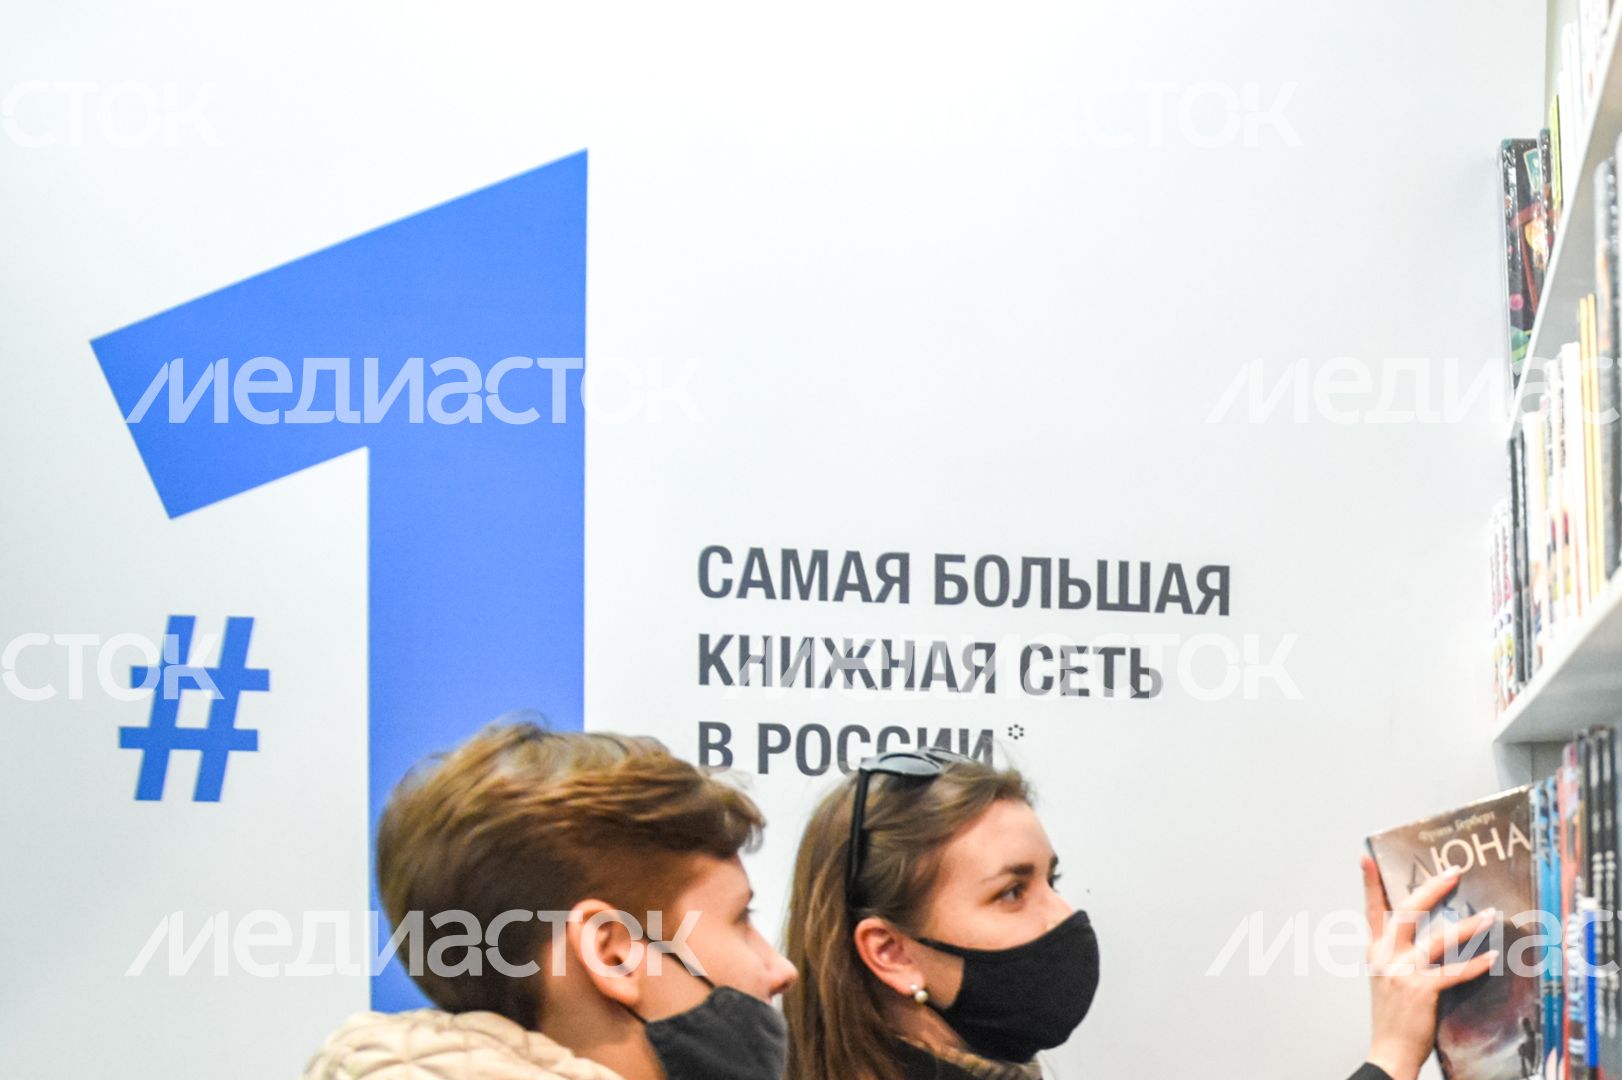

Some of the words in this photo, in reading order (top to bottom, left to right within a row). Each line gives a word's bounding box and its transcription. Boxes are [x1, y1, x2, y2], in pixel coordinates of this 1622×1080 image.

[698, 545, 910, 604] САМАЯ
[933, 553, 1231, 616] БОЛЬШАЯ
[698, 633, 996, 694] КНИЖНАЯ
[1019, 644, 1164, 699] СЕТЬ
[698, 721, 733, 770] В
